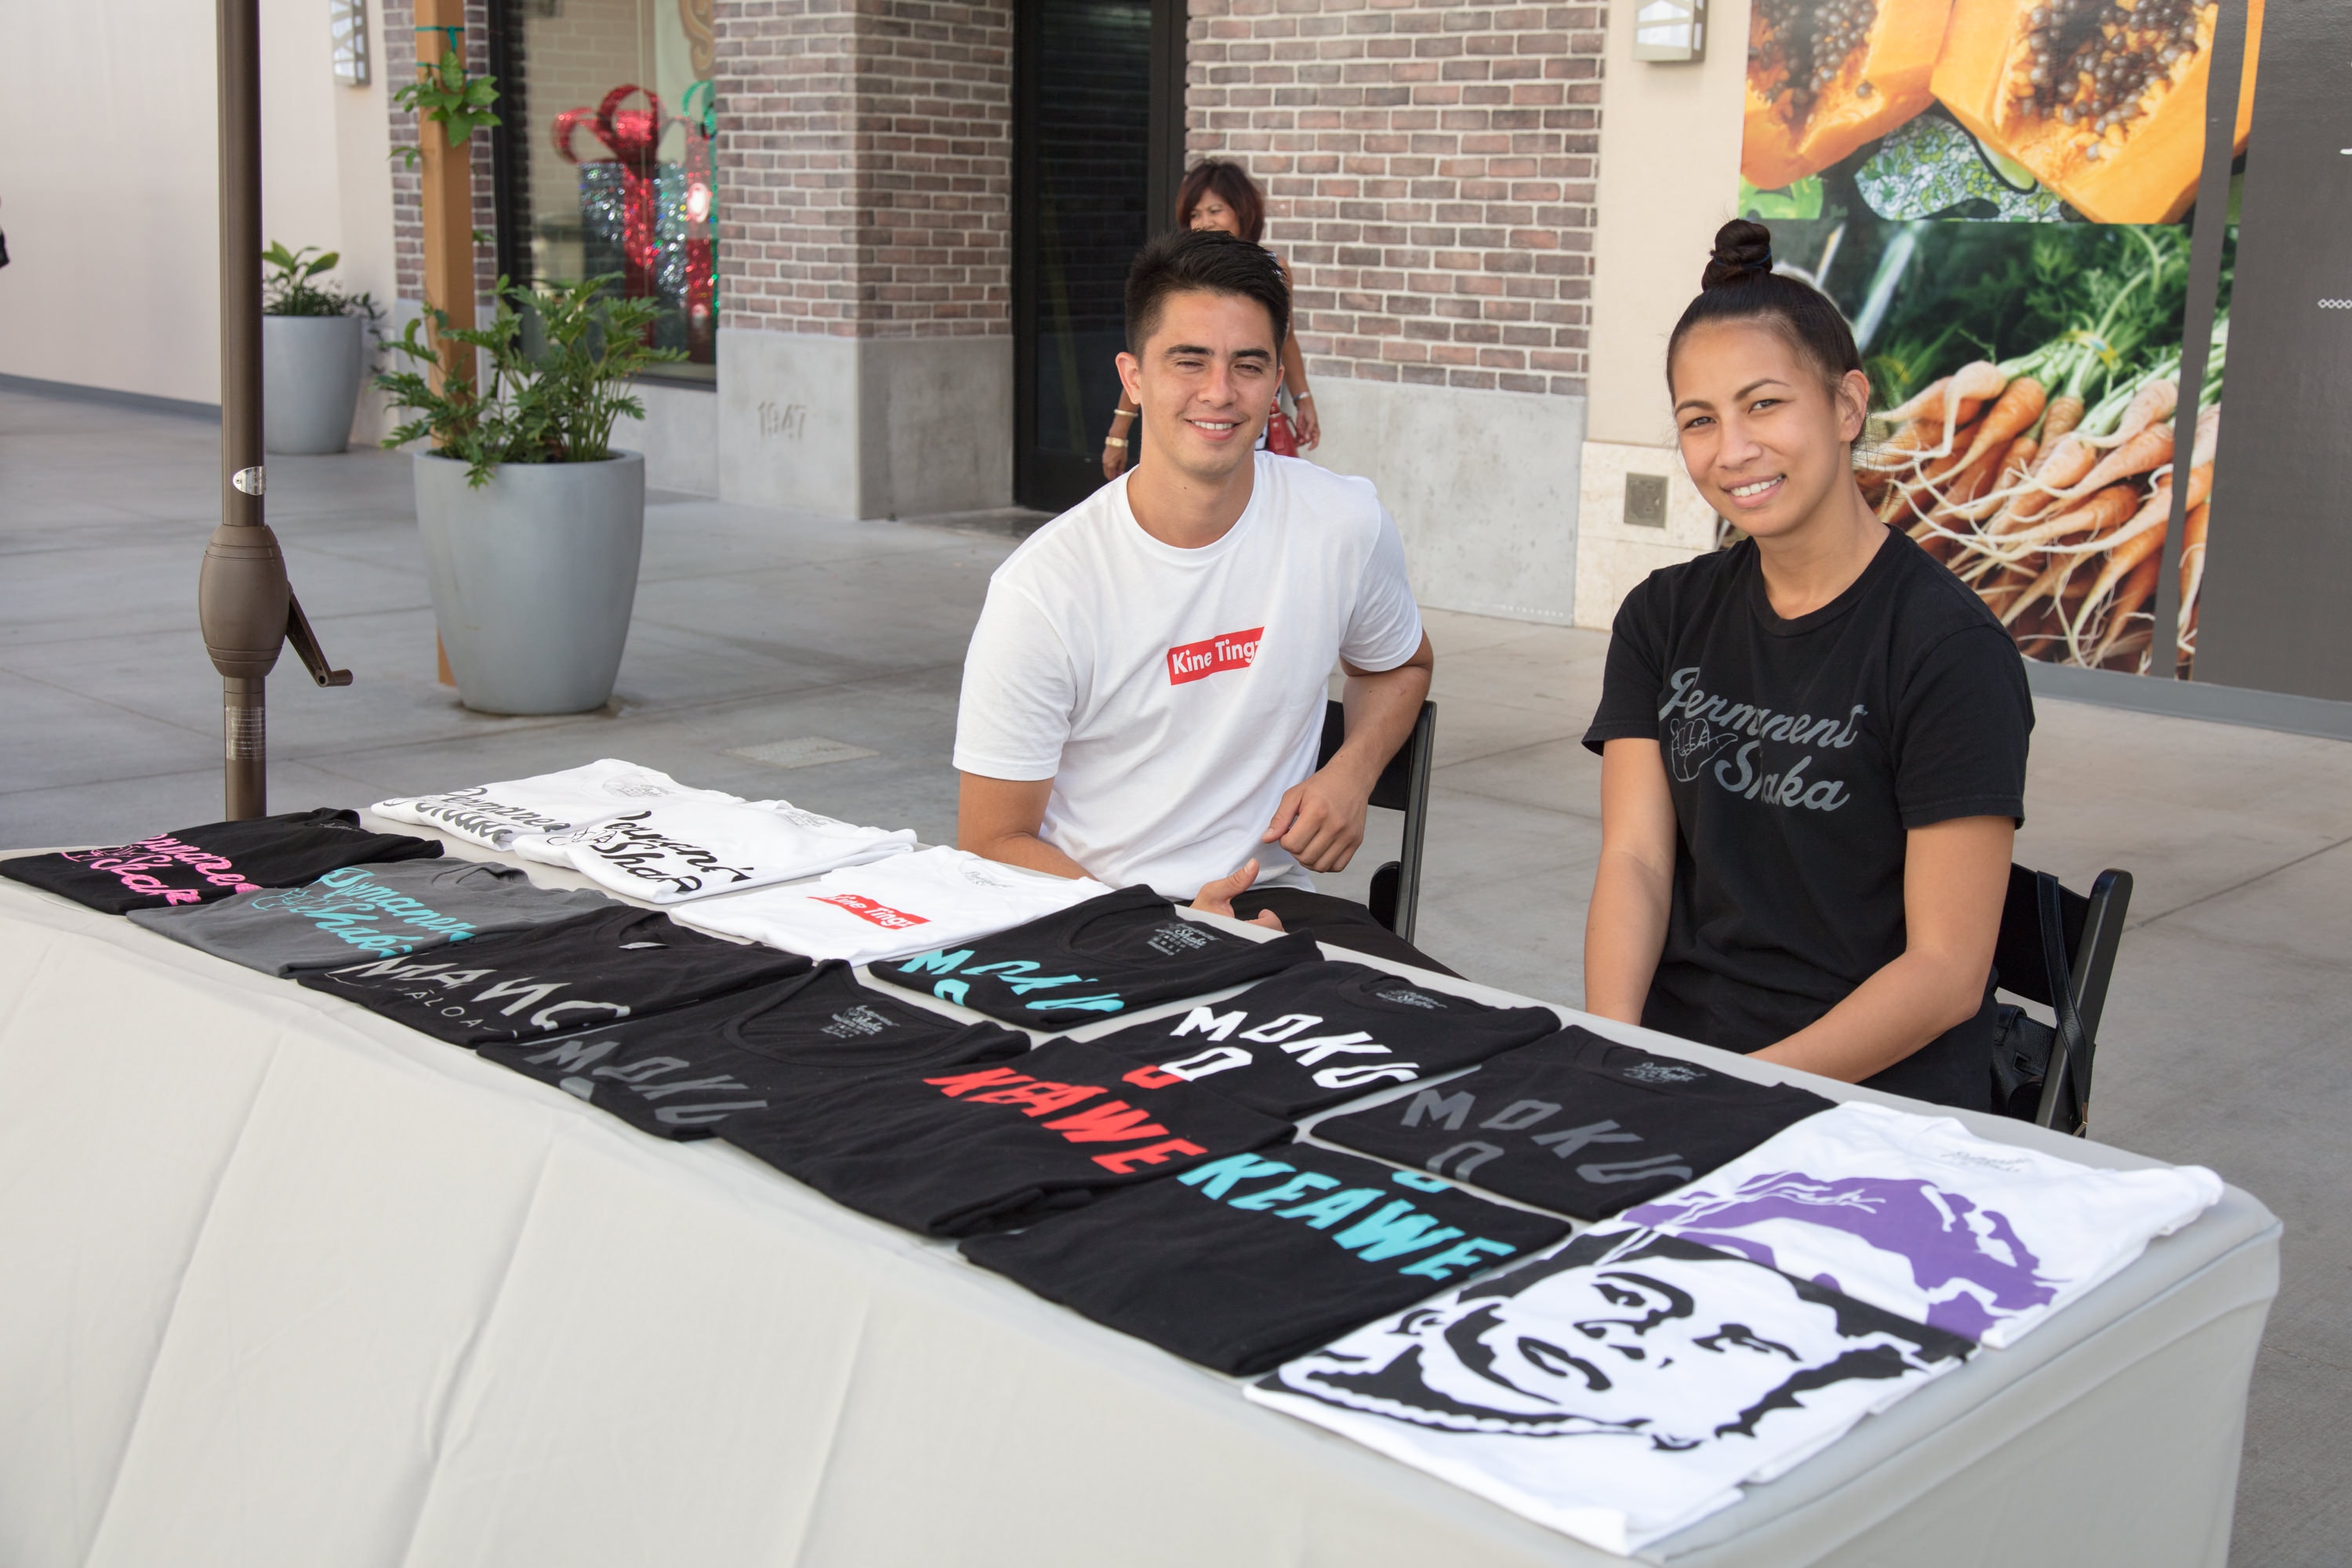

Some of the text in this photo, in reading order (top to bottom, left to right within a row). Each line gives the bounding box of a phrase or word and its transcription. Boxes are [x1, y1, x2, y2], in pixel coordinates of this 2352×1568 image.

[1172, 649, 1212, 674] Kine
[89, 854, 201, 906] Shak
[588, 841, 702, 893] Shak
[289, 902, 424, 959] Shak
[522, 1040, 768, 1124] MOKU
[1169, 1006, 1420, 1089] MOKU
[1400, 1089, 1693, 1184] MOKU
[1177, 1152, 1518, 1281] KEAWE
